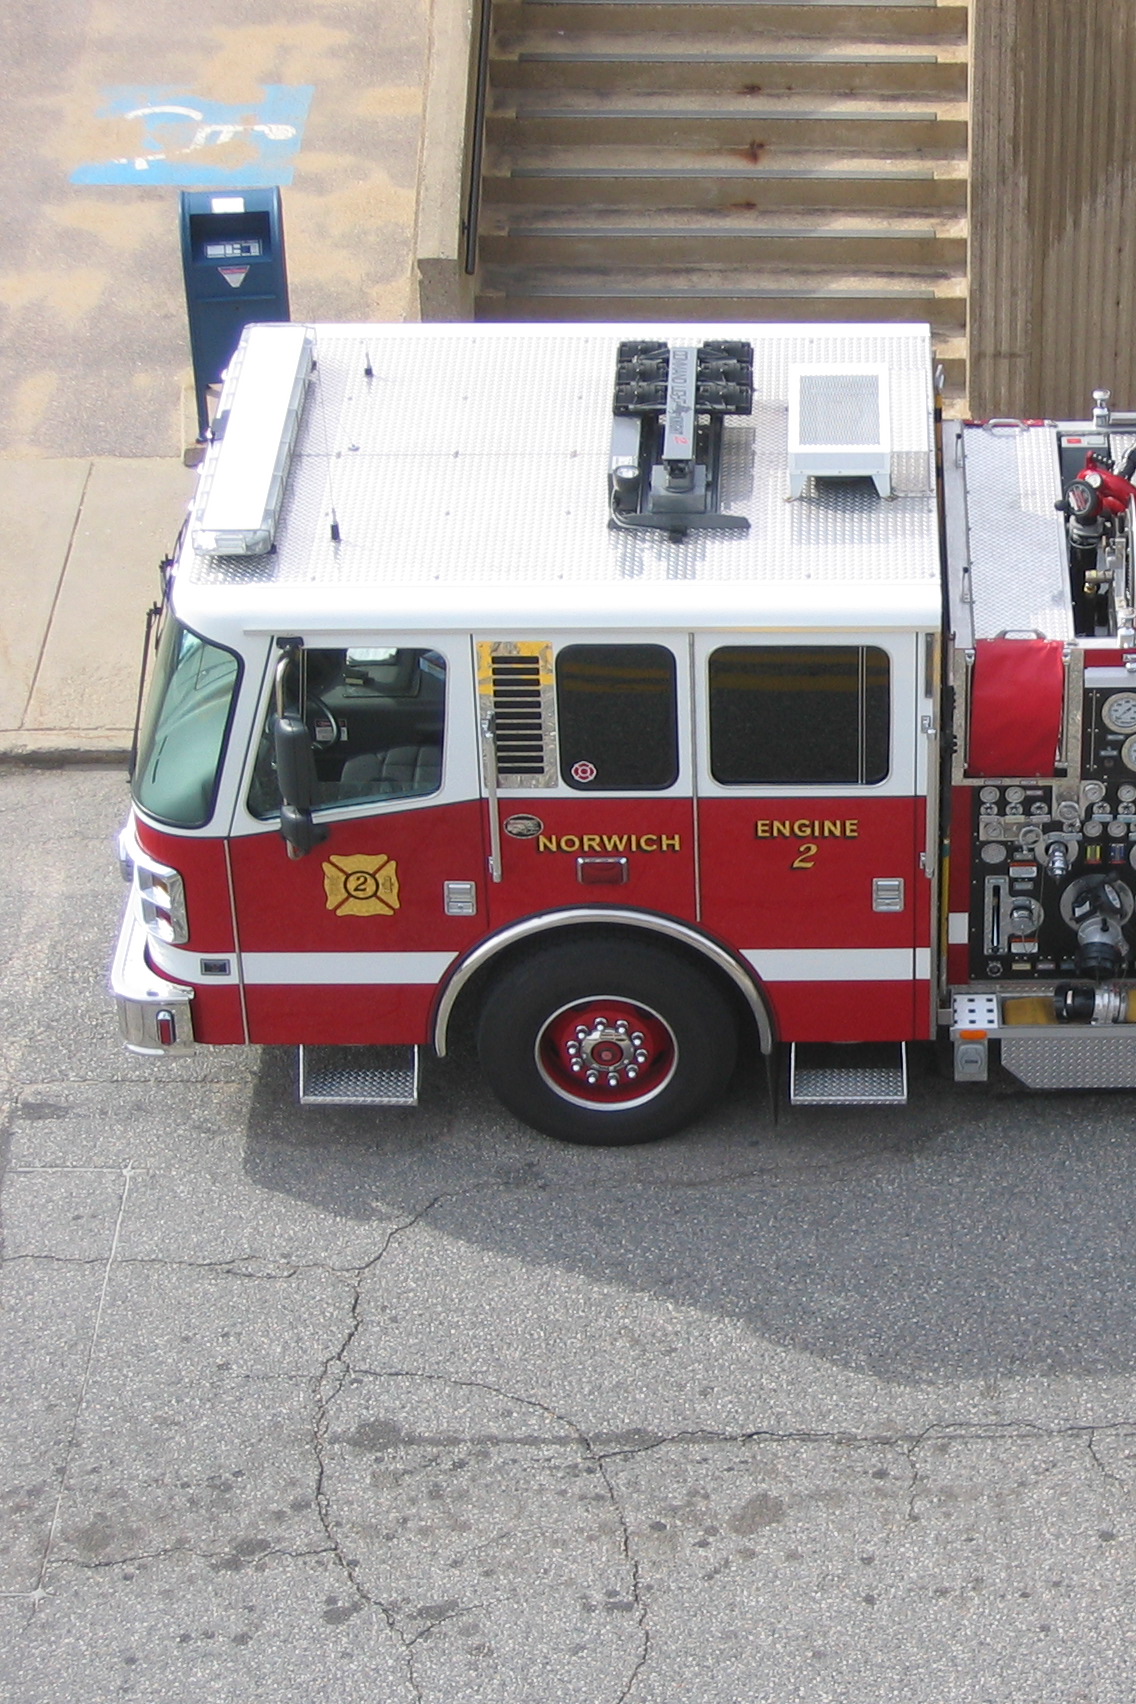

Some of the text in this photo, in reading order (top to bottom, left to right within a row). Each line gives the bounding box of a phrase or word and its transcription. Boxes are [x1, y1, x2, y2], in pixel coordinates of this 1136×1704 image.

[756, 819, 859, 838] ENGINE
[537, 833, 681, 853] NORWICH
[791, 843, 819, 869] 2
[353, 875, 368, 892] 2
